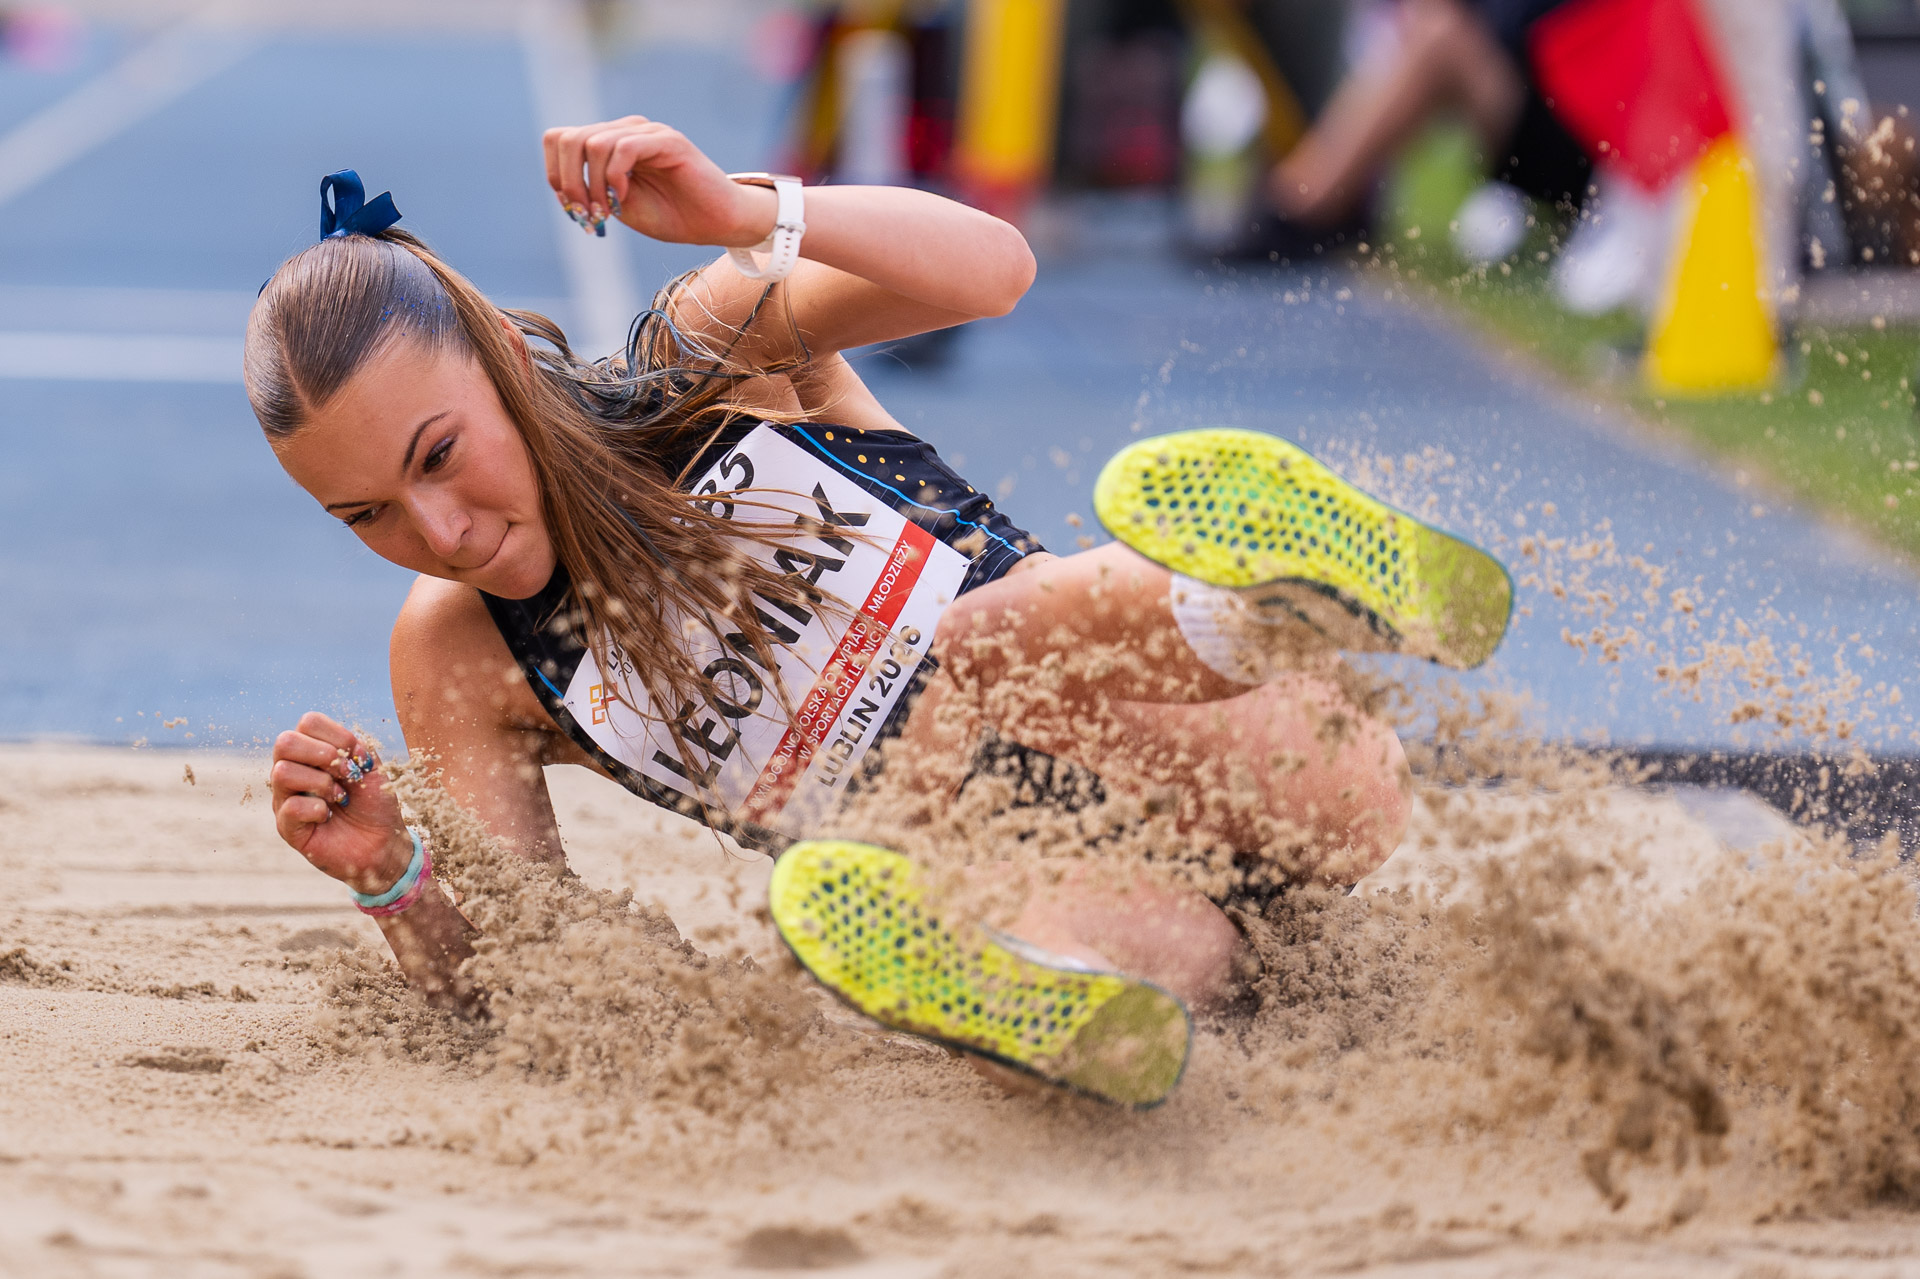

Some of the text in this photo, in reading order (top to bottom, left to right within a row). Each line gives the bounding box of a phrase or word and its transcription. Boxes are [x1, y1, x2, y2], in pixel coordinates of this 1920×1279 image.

[867, 539, 911, 613] MŁODZIEŻY
[653, 482, 871, 791] LEONIAK
[797, 620, 889, 760] W SPORTACH LENICH
[815, 697, 880, 788] LUBLIN
